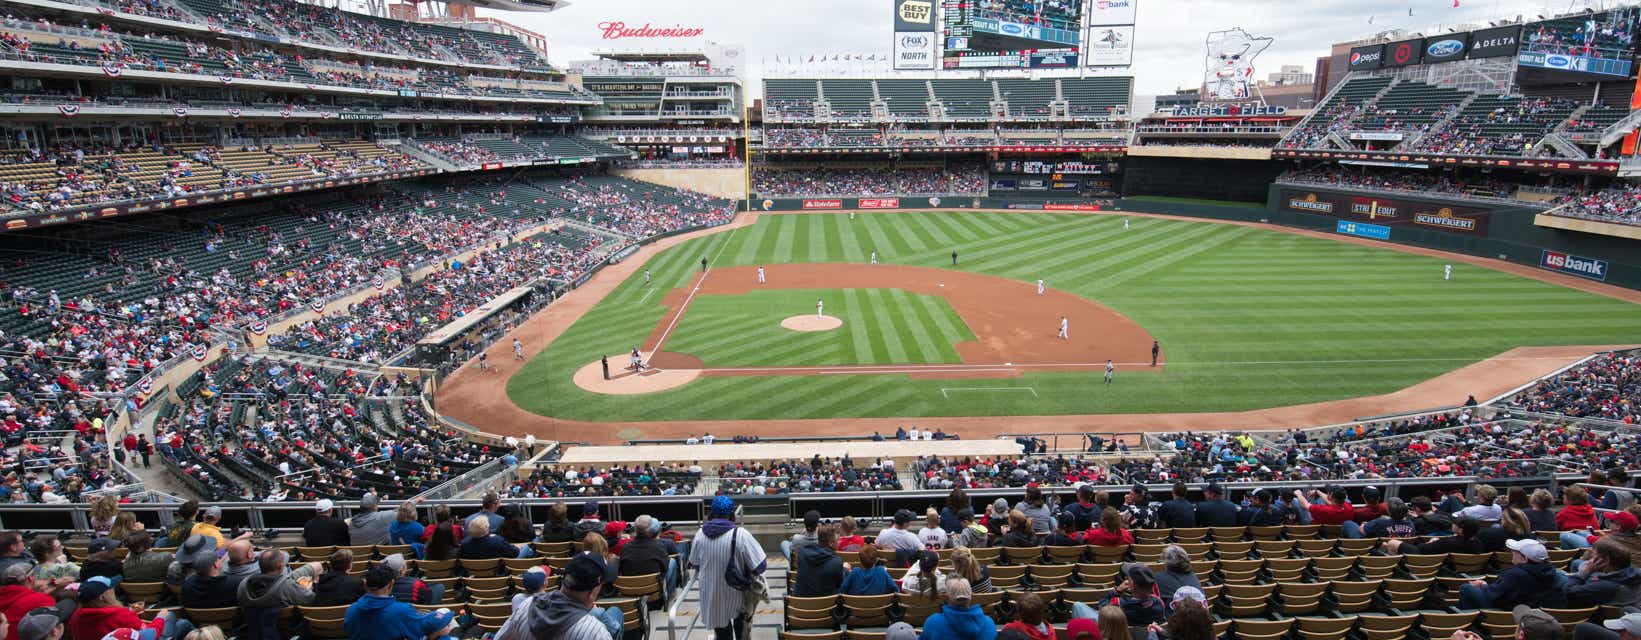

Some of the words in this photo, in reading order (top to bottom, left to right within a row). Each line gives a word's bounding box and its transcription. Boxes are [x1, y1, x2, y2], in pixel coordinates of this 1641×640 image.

[904, 4, 930, 13] BEST
[904, 12, 927, 20] BUY
[598, 21, 704, 39] Budweiser
[907, 36, 923, 45] FOX
[1483, 37, 1515, 48] DELTA
[1434, 45, 1455, 55] Ford
[901, 52, 929, 60] NORTH
[1360, 52, 1380, 63] pepsi
[1172, 106, 1227, 116] TARGET
[1241, 106, 1288, 116] FIELD
[1354, 204, 1397, 215] STRIEOUT
[1417, 215, 1473, 228] SCHWEIGERT
